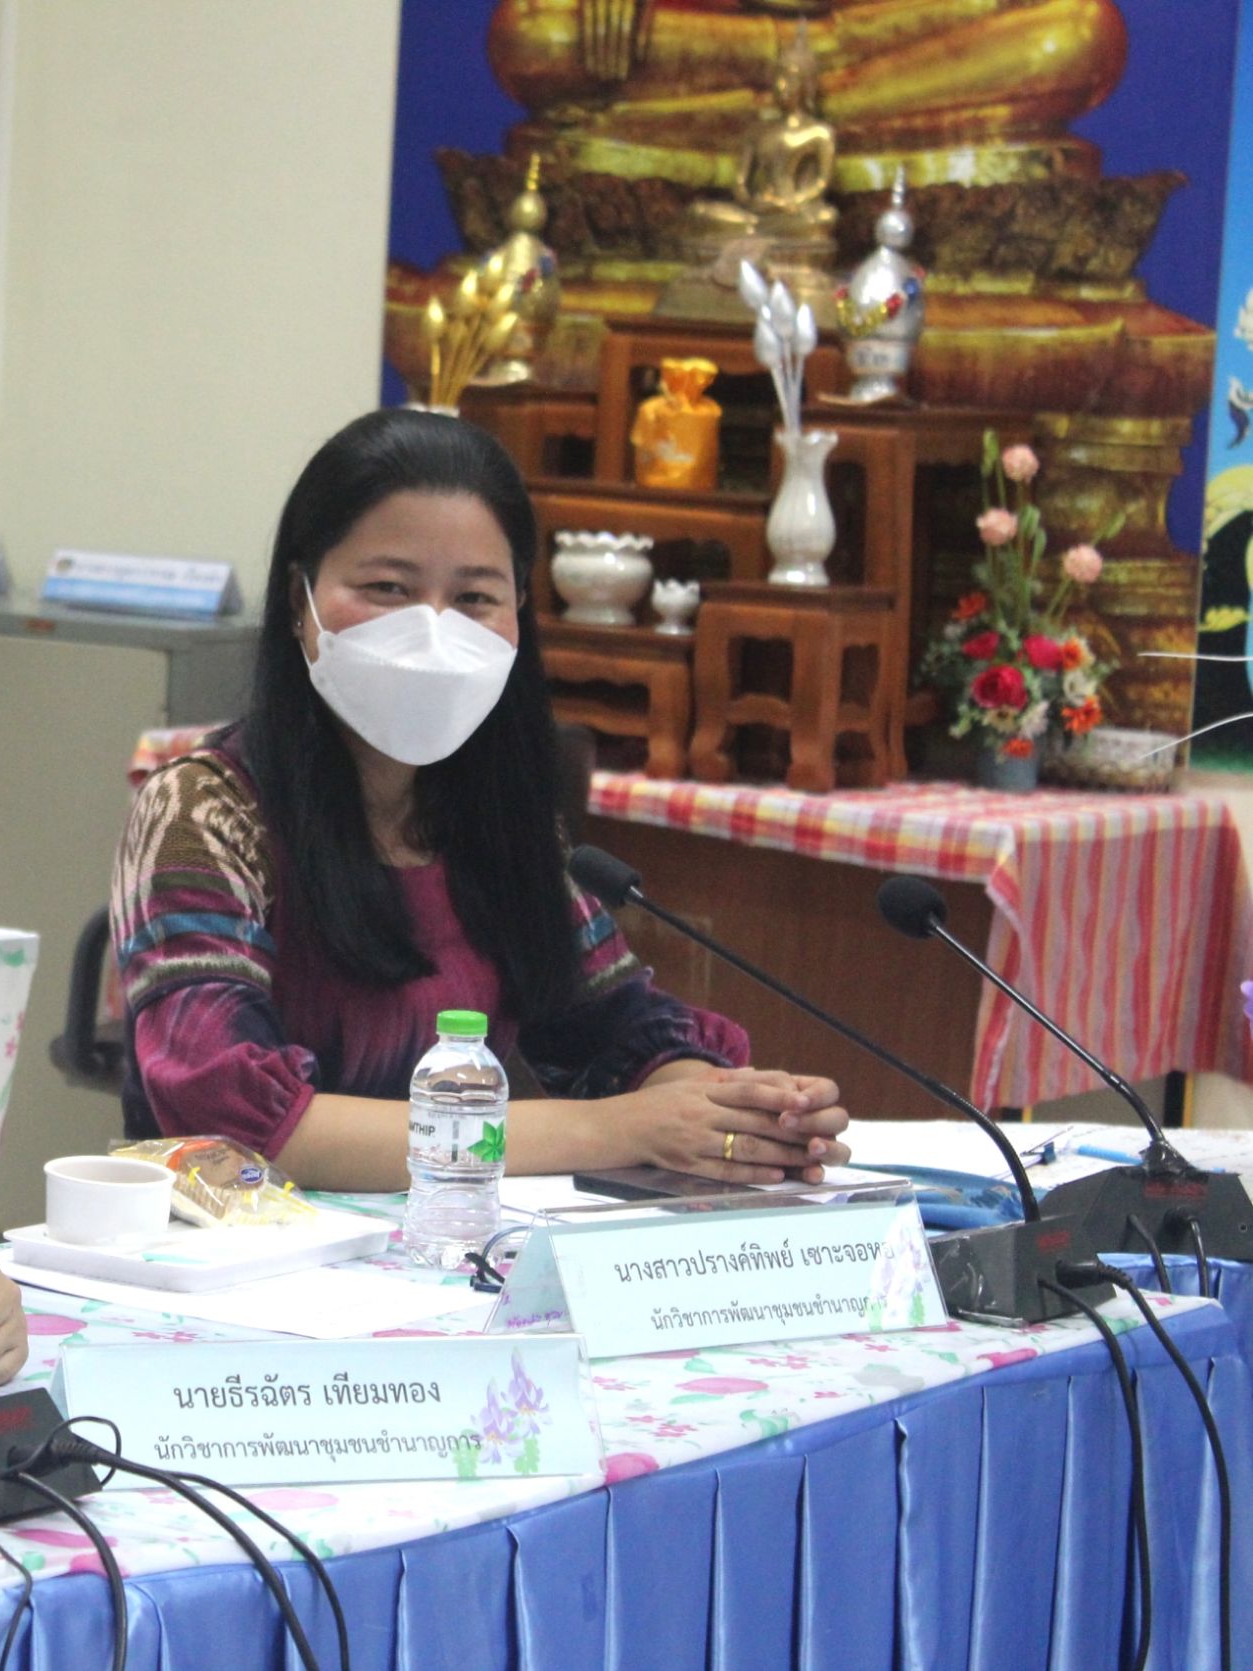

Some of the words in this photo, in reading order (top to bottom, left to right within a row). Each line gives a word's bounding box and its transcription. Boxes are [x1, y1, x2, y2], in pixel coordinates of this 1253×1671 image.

[614, 1238, 795, 1283] นางสาวปรางค์ทิพย์
[172, 1373, 312, 1409] นายธีรฉัตร
[323, 1371, 442, 1406] เทียมทอง
[153, 1429, 482, 1464] นักวิชาการพัฒนาชุมชนชำนาญการ
